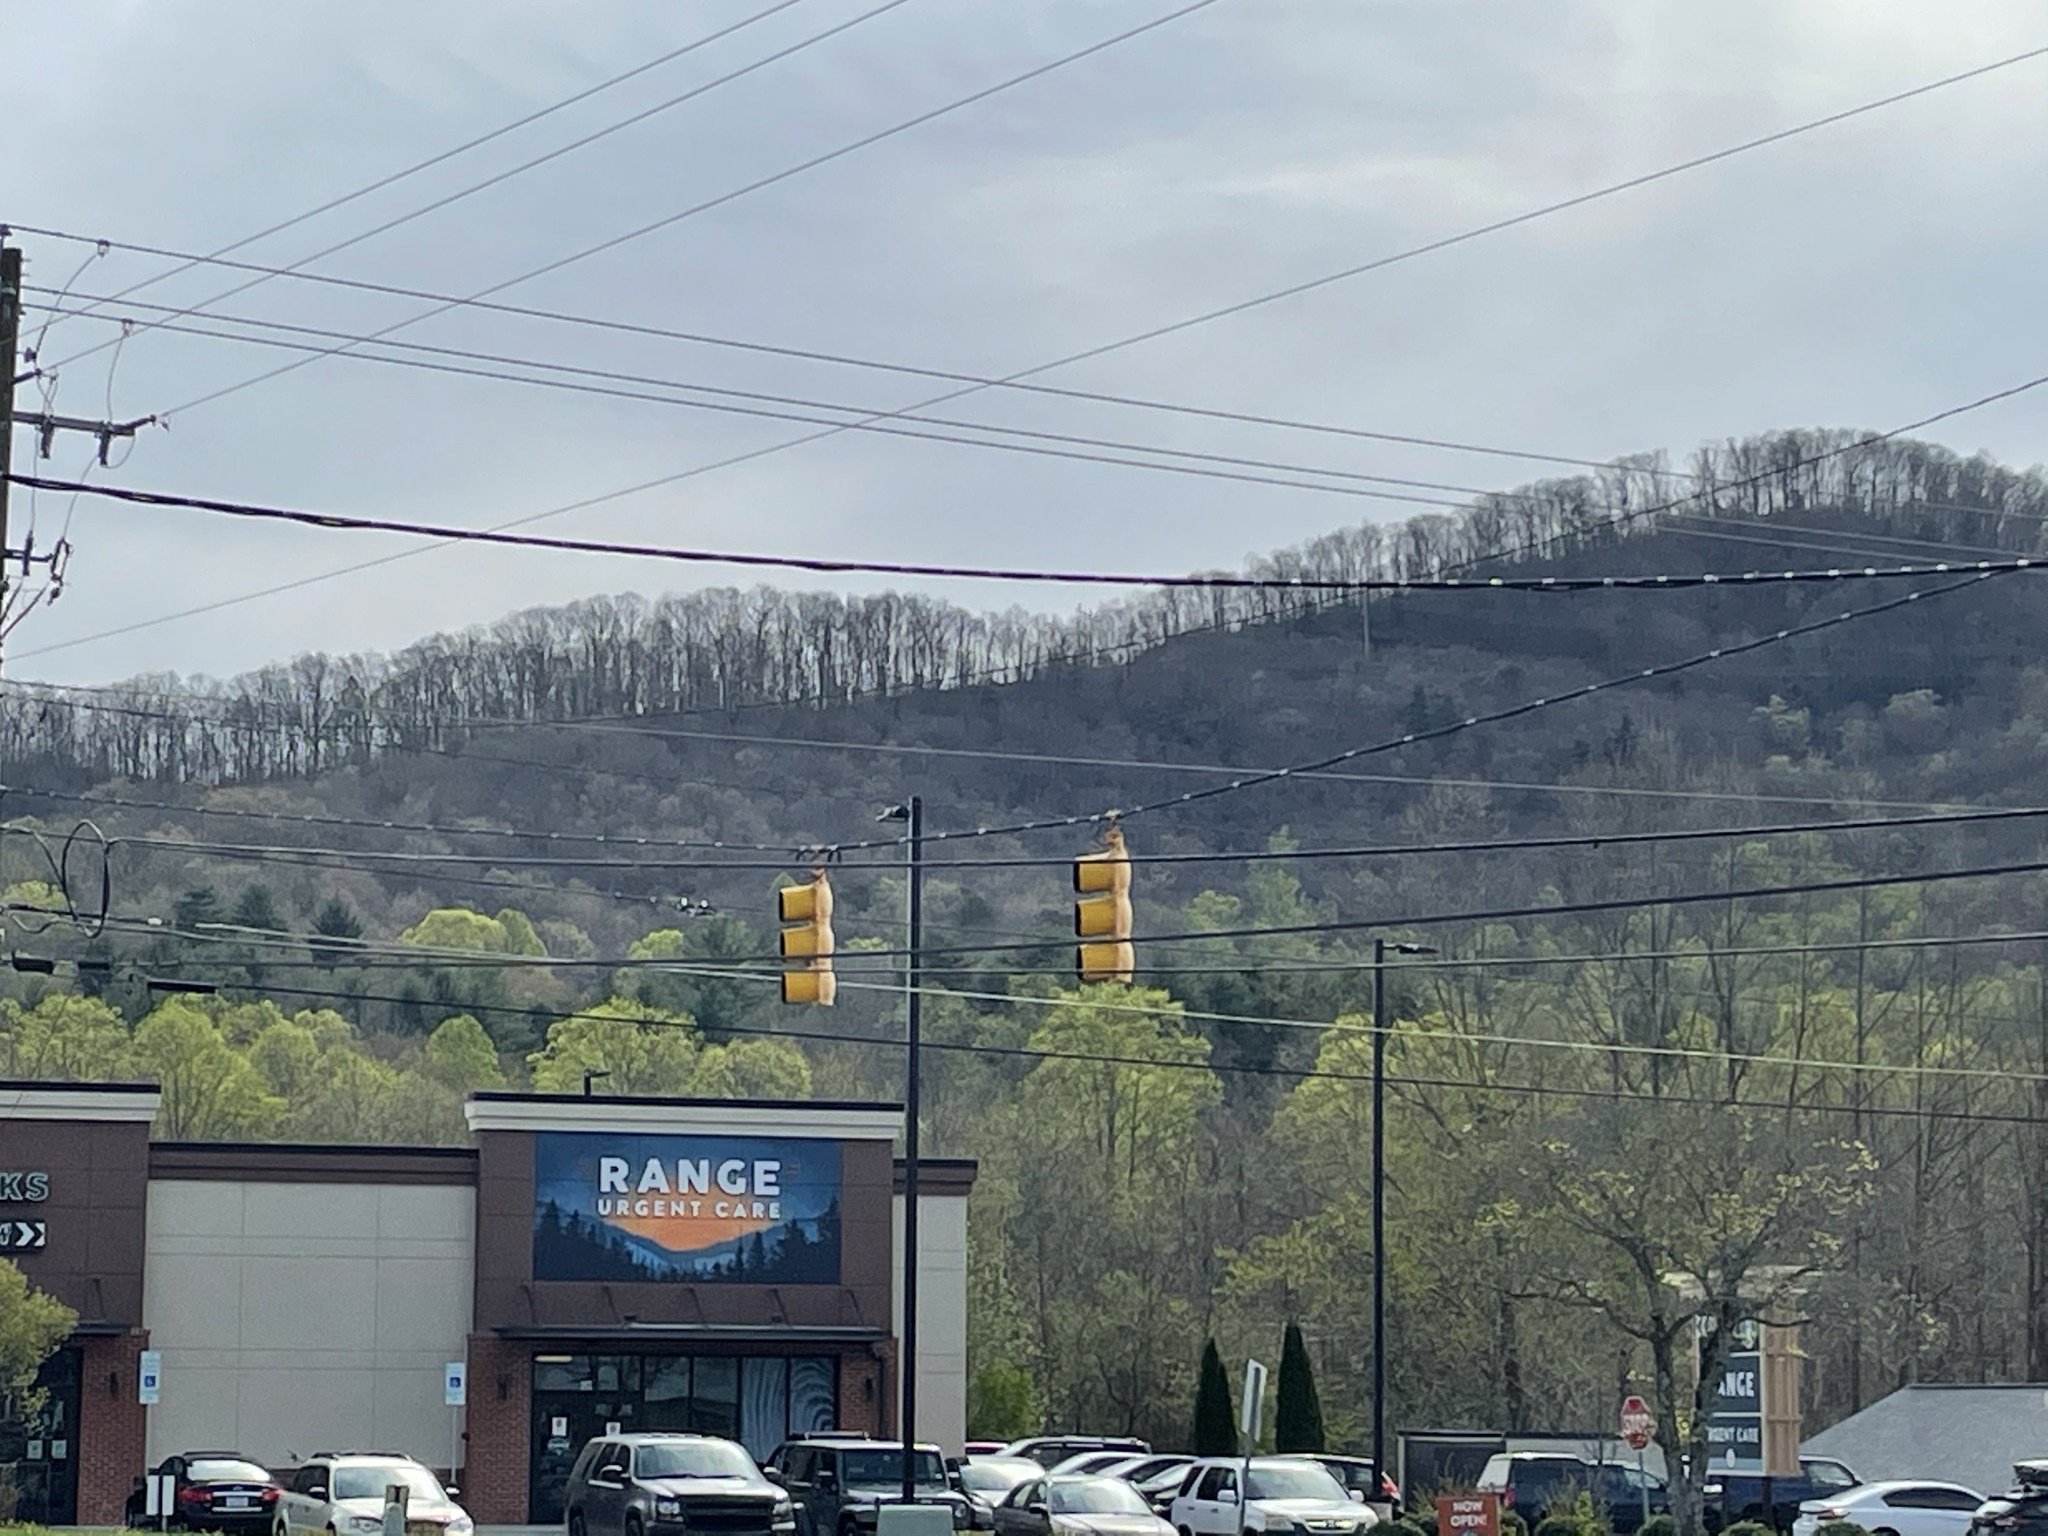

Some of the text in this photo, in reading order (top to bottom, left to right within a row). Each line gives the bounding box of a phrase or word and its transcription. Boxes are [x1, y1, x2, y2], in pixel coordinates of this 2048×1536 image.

[600, 1157, 781, 1196] RANGE
[598, 1198, 781, 1219] URGENT CARE
[1718, 1371, 1755, 1397] ANGE
[1705, 1427, 1759, 1443] RGENT CARE
[1453, 1500, 1483, 1513] NOW
